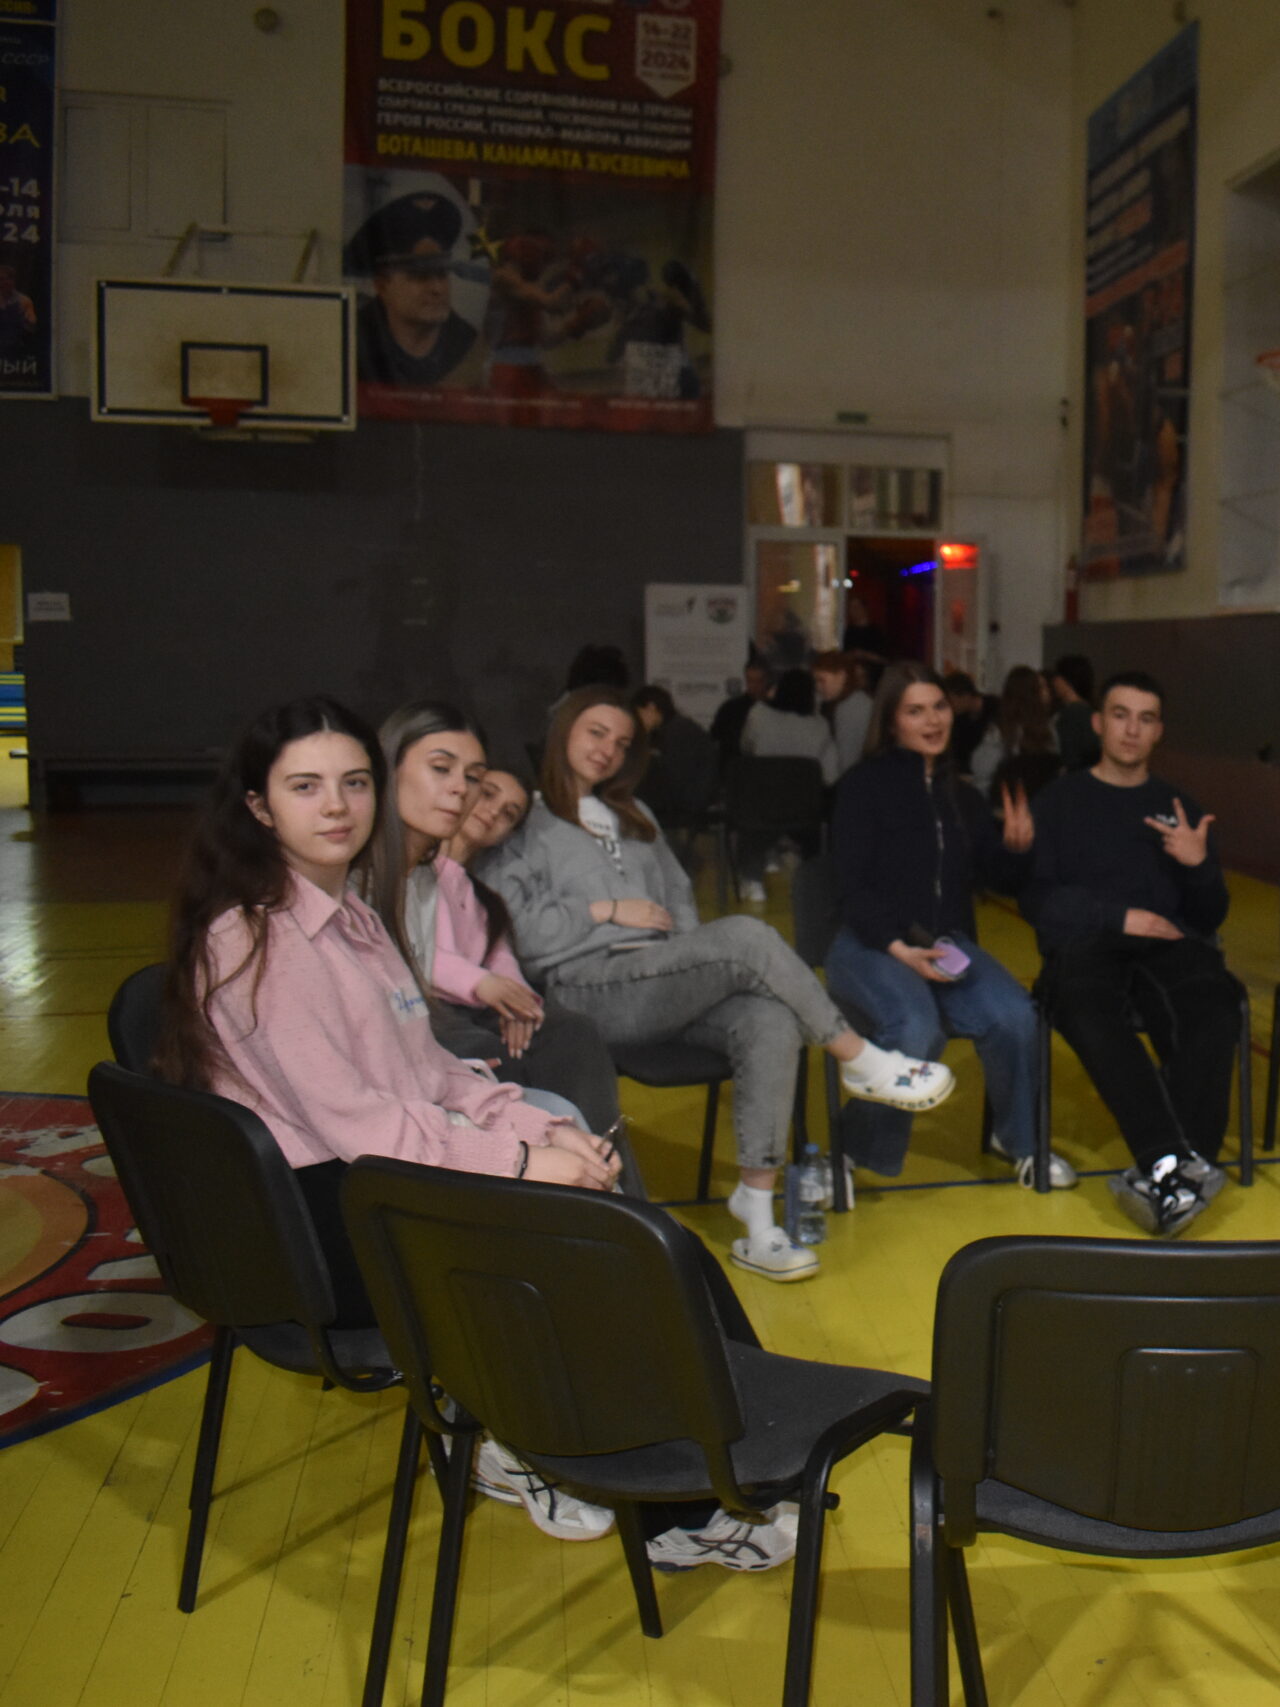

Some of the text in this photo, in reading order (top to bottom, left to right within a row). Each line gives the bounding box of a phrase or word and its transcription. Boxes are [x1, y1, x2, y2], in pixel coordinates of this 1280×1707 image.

[381, 0, 611, 80] БОКС
[641, 49, 691, 71] 2024
[377, 77, 500, 102] ВСЕРОССИЙСКИЕ
[376, 132, 690, 178] БОТАШЕВА КАНАМАТА ХУСЕЕВИЧА
